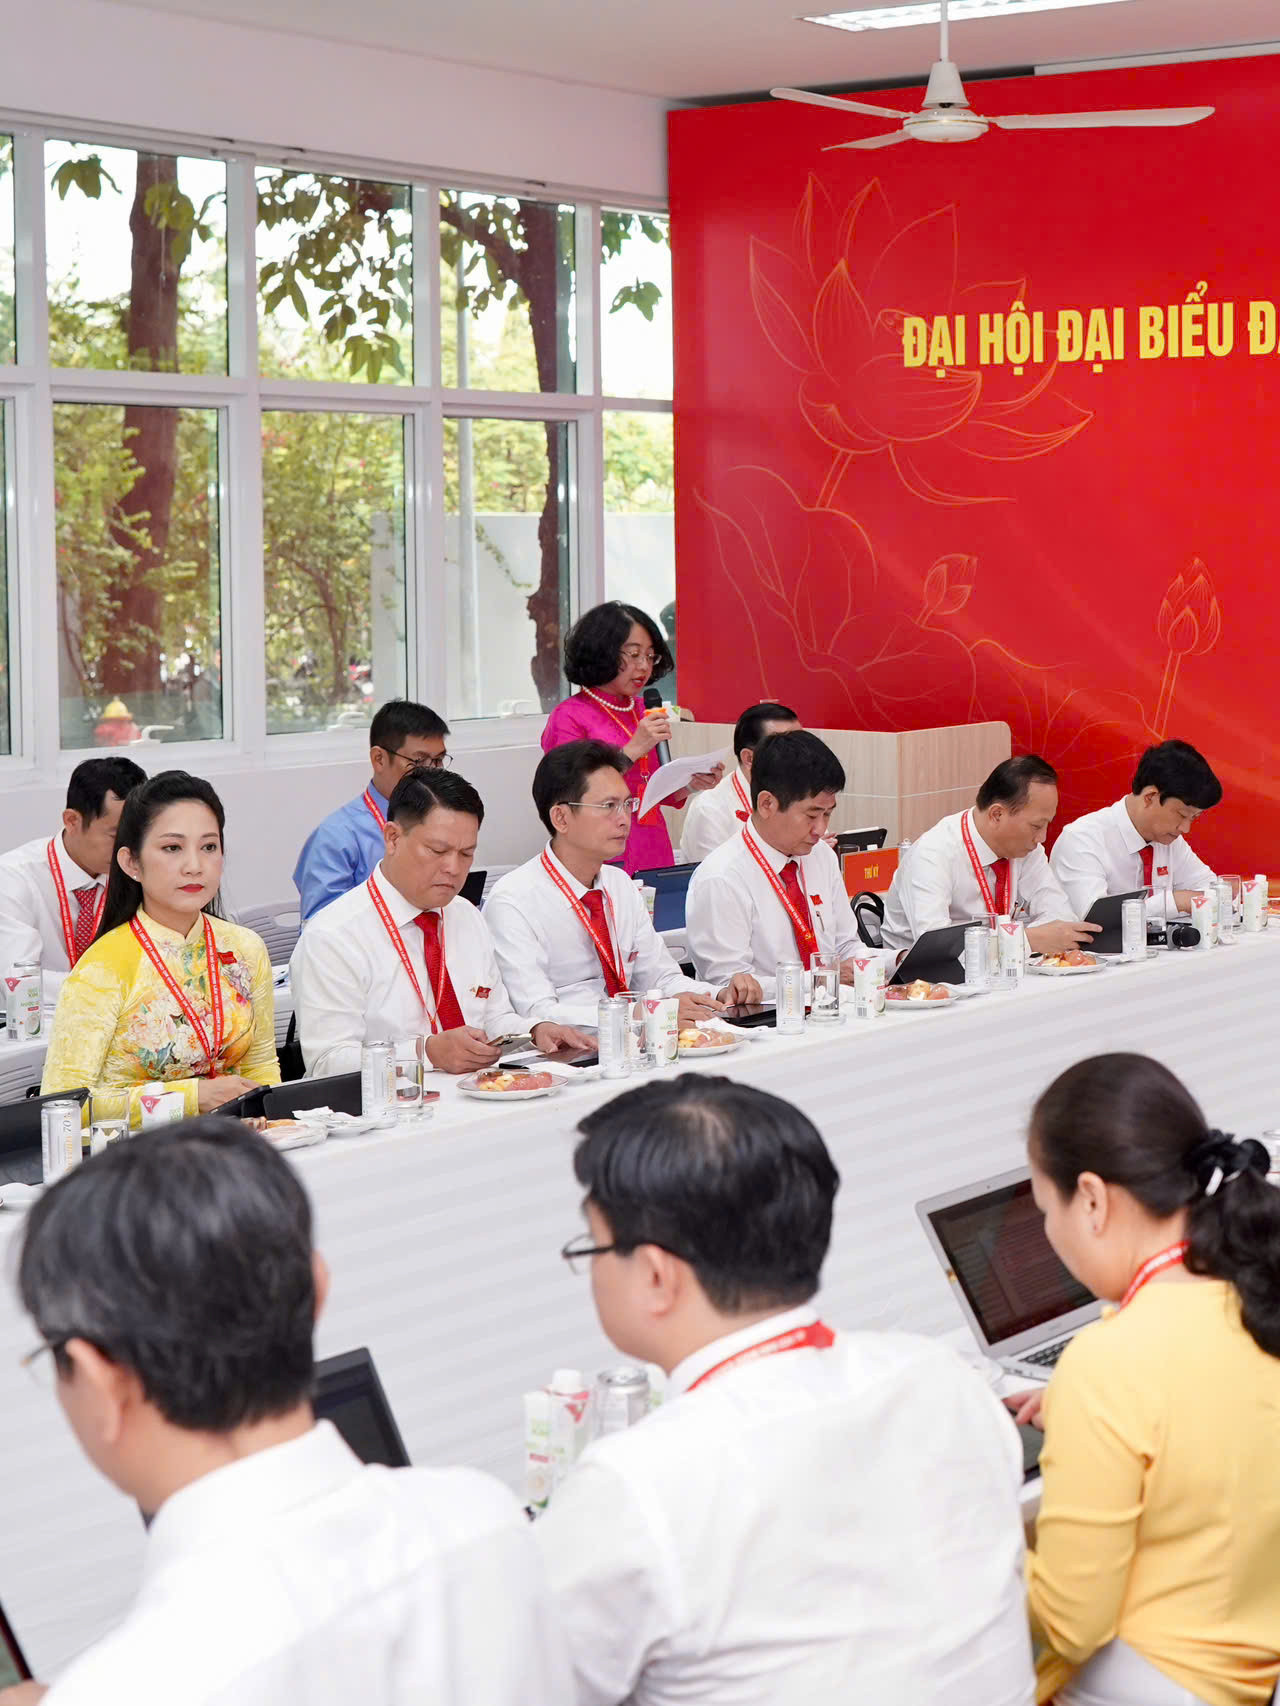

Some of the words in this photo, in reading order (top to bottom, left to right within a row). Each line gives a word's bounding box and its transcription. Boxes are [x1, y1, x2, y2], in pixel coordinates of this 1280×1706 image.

[901, 314, 966, 378] ĐẠI
[979, 301, 1044, 376] HỘI
[1056, 308, 1125, 372] ĐẠI
[1139, 281, 1234, 359] BIỂU
